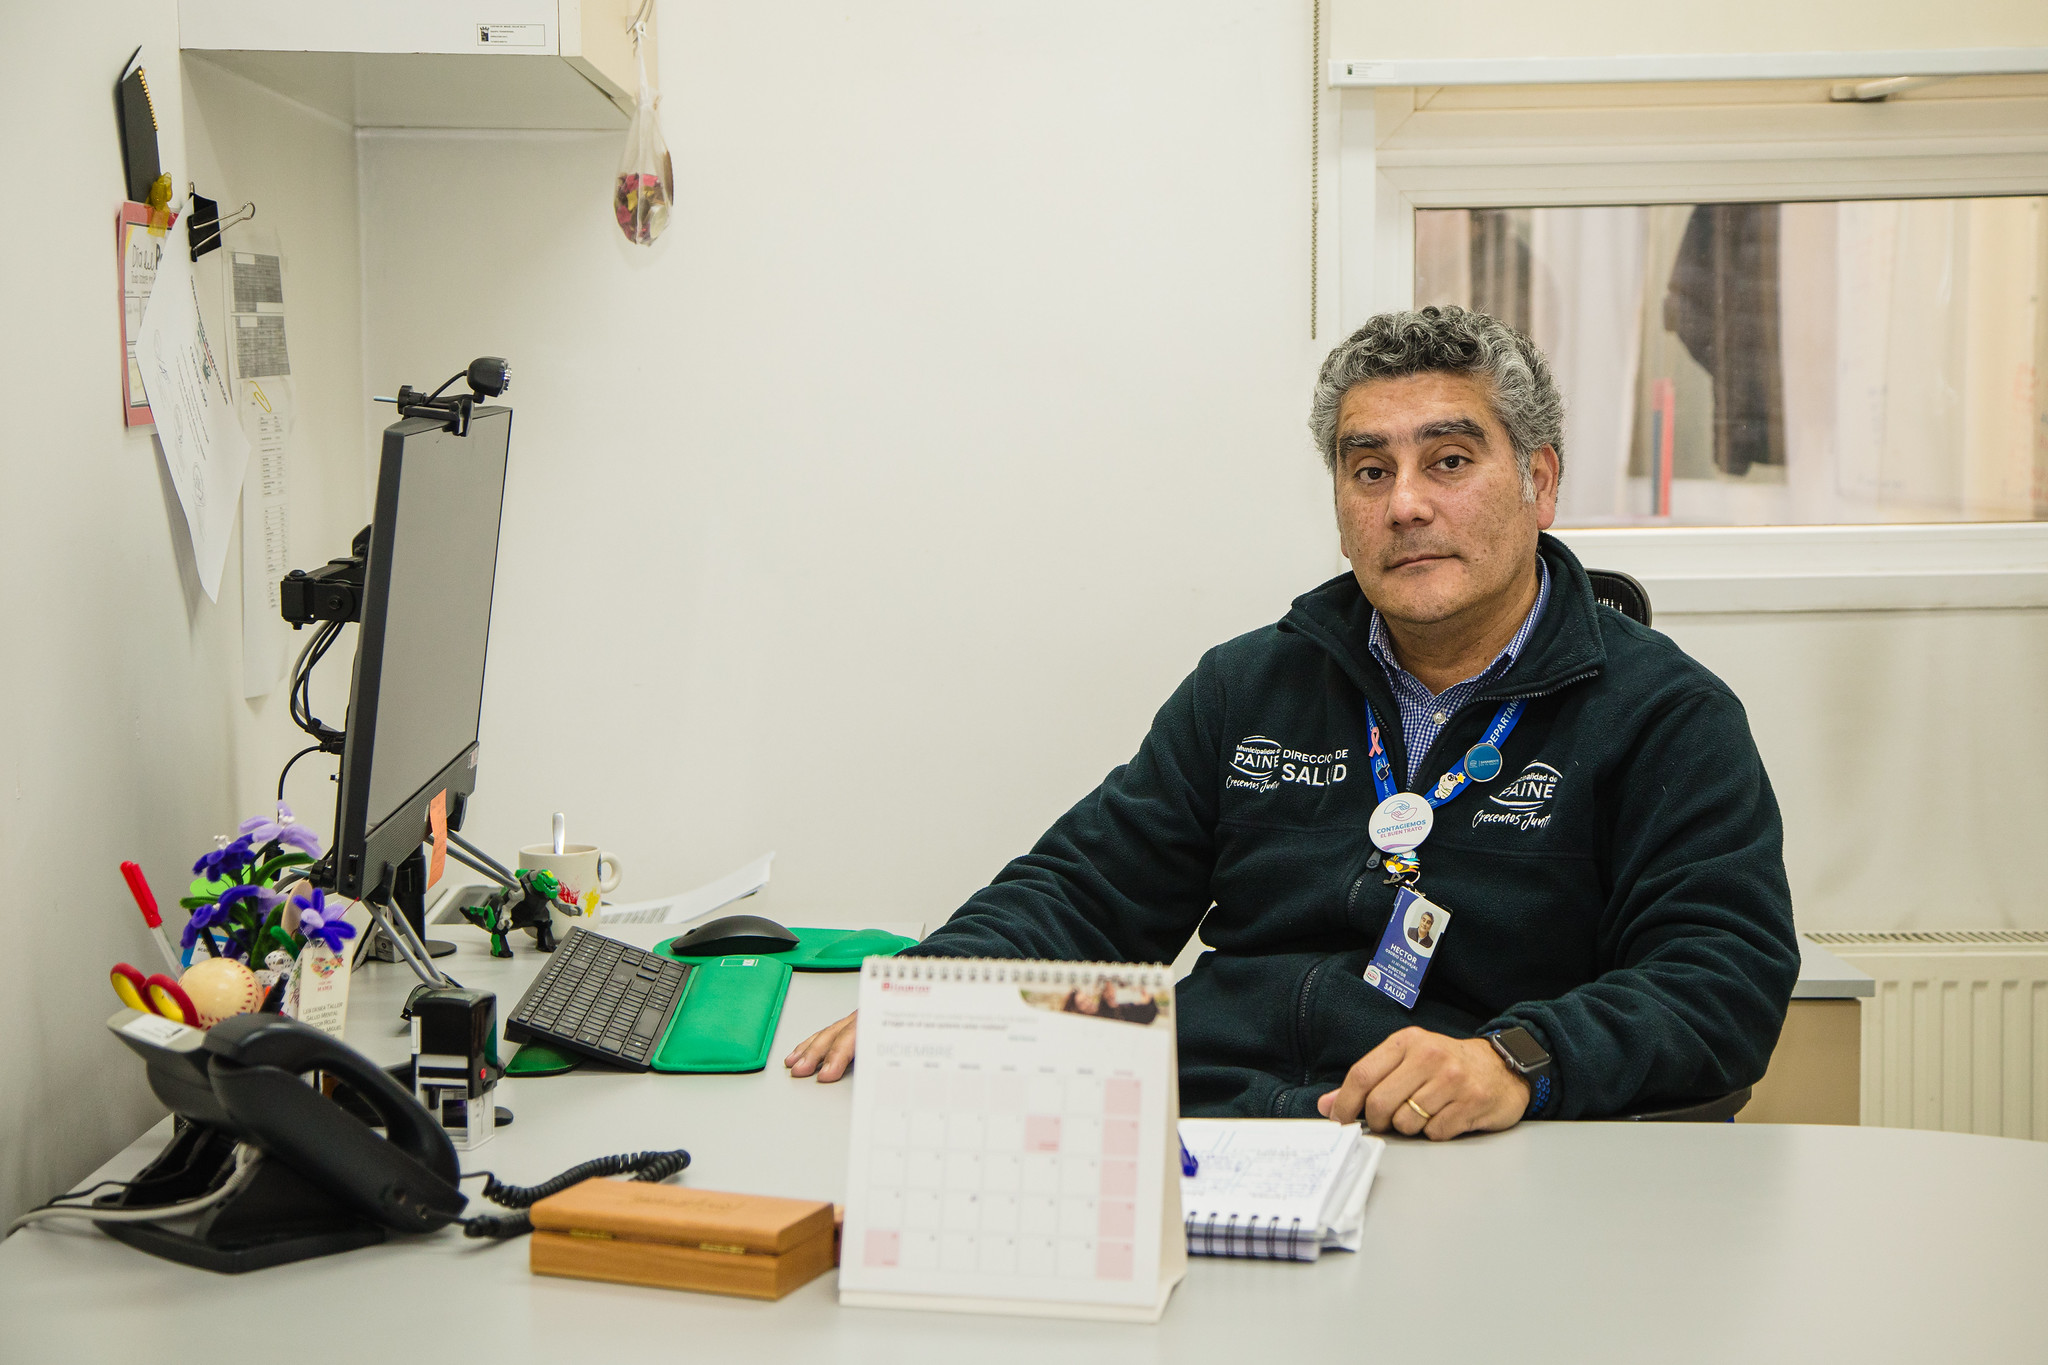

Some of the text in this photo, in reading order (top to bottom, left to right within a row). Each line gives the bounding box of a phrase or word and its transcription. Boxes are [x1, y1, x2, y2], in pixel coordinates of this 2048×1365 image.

[1486, 697, 1521, 746] DEPARTAM
[1234, 752, 1279, 769] PAINE
[1283, 749, 1349, 764] DIRECCIO DE
[1377, 820, 1426, 834] CONTAGIEMOS
[1472, 809, 1521, 828] Crecemos
[1390, 943, 1418, 964] HECTOR
[1384, 983, 1406, 1000] SALUD
